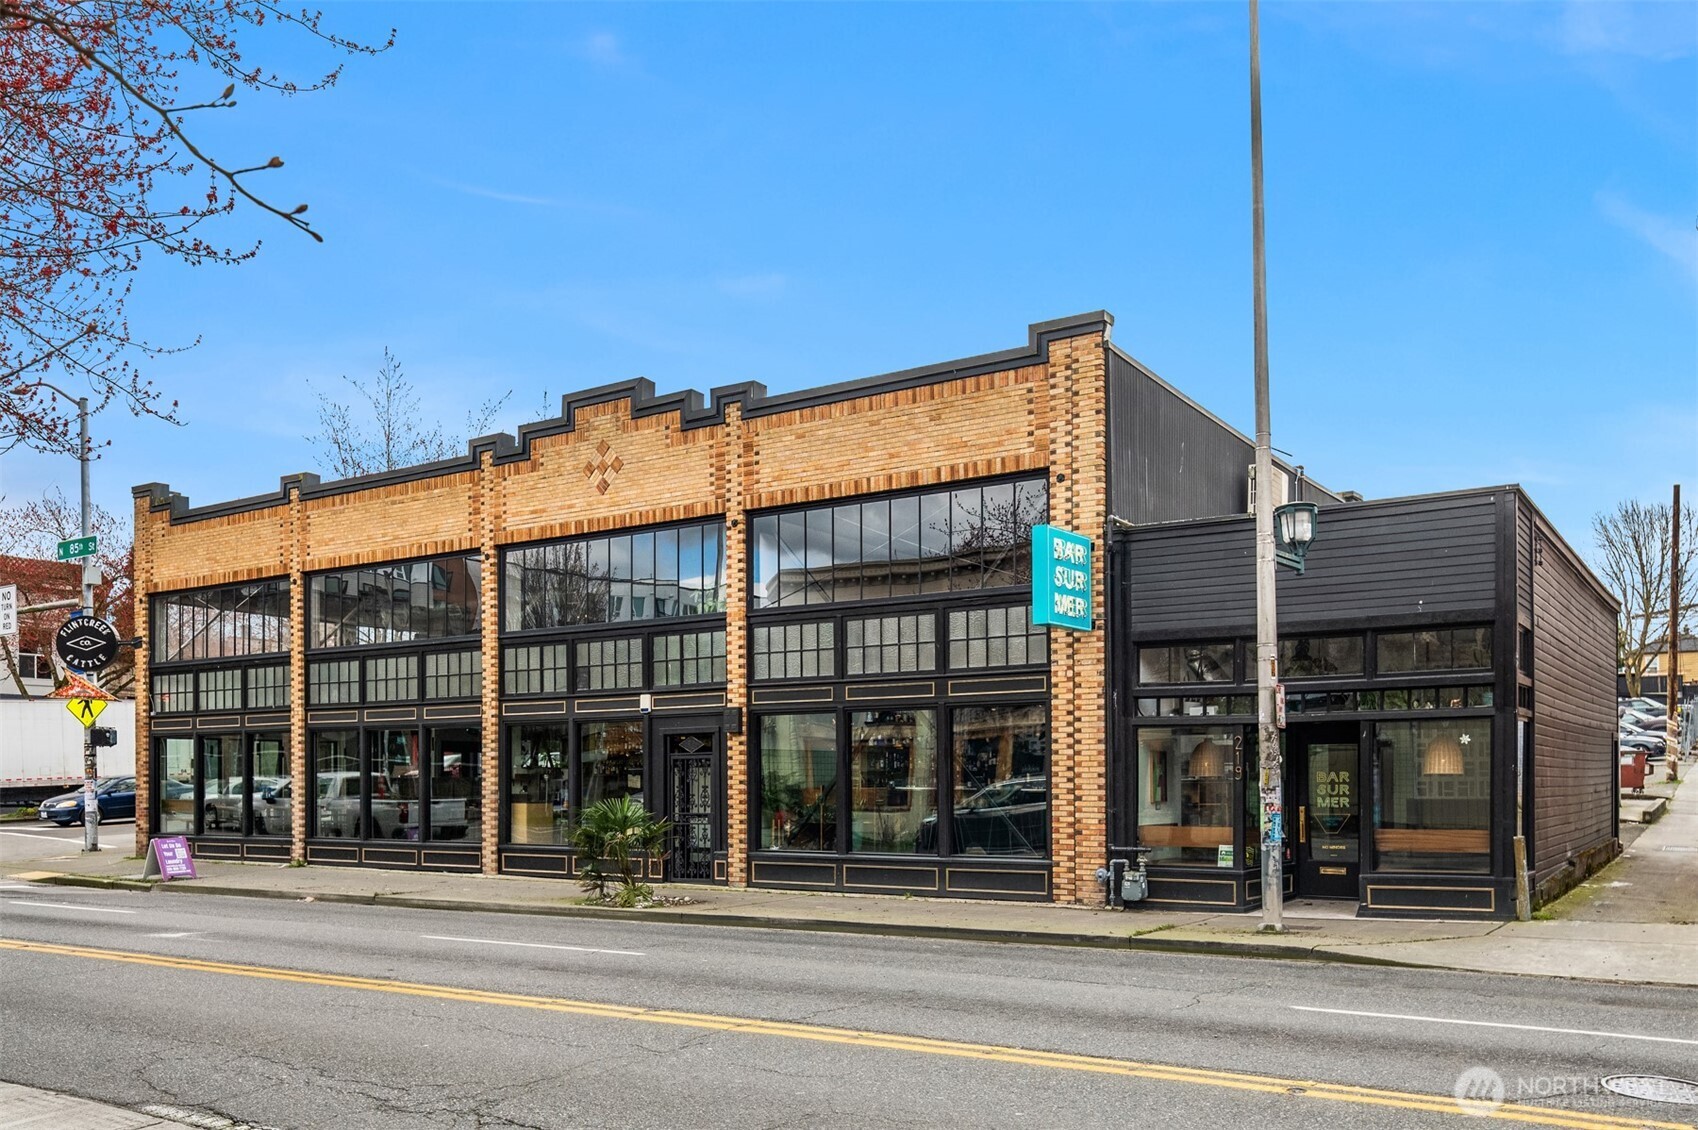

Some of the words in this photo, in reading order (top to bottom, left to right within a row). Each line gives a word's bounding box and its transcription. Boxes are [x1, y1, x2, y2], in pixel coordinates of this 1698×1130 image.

[58, 547, 64, 556] N
[88, 541, 95, 551] St
[1053, 537, 1088, 566] BAR
[1053, 565, 1088, 592] SUR
[1, 590, 12, 601] NO
[1, 602, 13, 611] TURN
[1053, 592, 1088, 619] MER
[3, 613, 11, 621] ON
[2, 622, 12, 630] RED
[60, 618, 112, 637] FLINTCREEK
[66, 653, 107, 668] CATTLE
[1233, 735, 1242, 781] 219
[1316, 770, 1350, 783] BAR
[1316, 784, 1350, 796] SUR
[1316, 796, 1350, 808] MER
